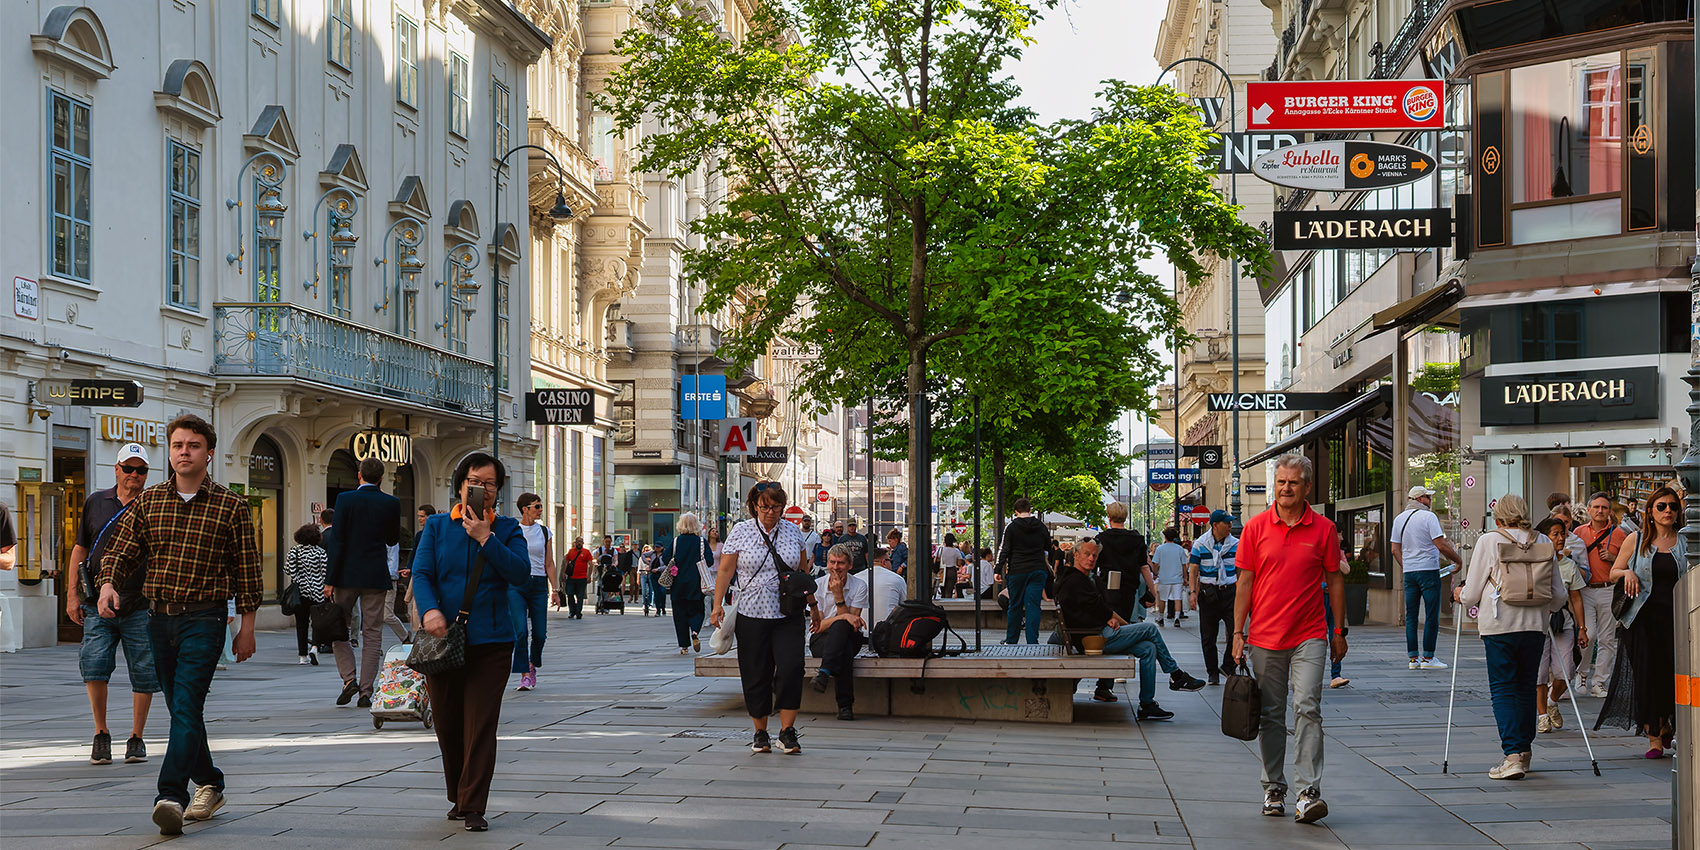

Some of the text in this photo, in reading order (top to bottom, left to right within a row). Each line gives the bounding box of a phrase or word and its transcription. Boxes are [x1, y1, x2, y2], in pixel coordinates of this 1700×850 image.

[1284, 96, 1349, 108] BURGER
[1406, 92, 1433, 106] BURGER
[1408, 99, 1434, 114] KING
[1284, 108, 1321, 116] Annagasse
[1261, 162, 1280, 170] Zipfer
[1282, 150, 1340, 168] Lubella
[1378, 162, 1407, 170] BAGELS
[1300, 165, 1339, 174] restaurant
[1294, 218, 1431, 240] LÄDERACH
[49, 386, 125, 400] WEMPE
[537, 391, 591, 406] CASINO
[684, 393, 712, 401] ERSTE
[1504, 379, 1625, 405] LÄDERACH
[545, 408, 583, 423] WIEN
[106, 416, 167, 445] WEMPE
[723, 421, 752, 452] A1
[353, 433, 409, 464] CASINO
[249, 454, 275, 472] EMPE
